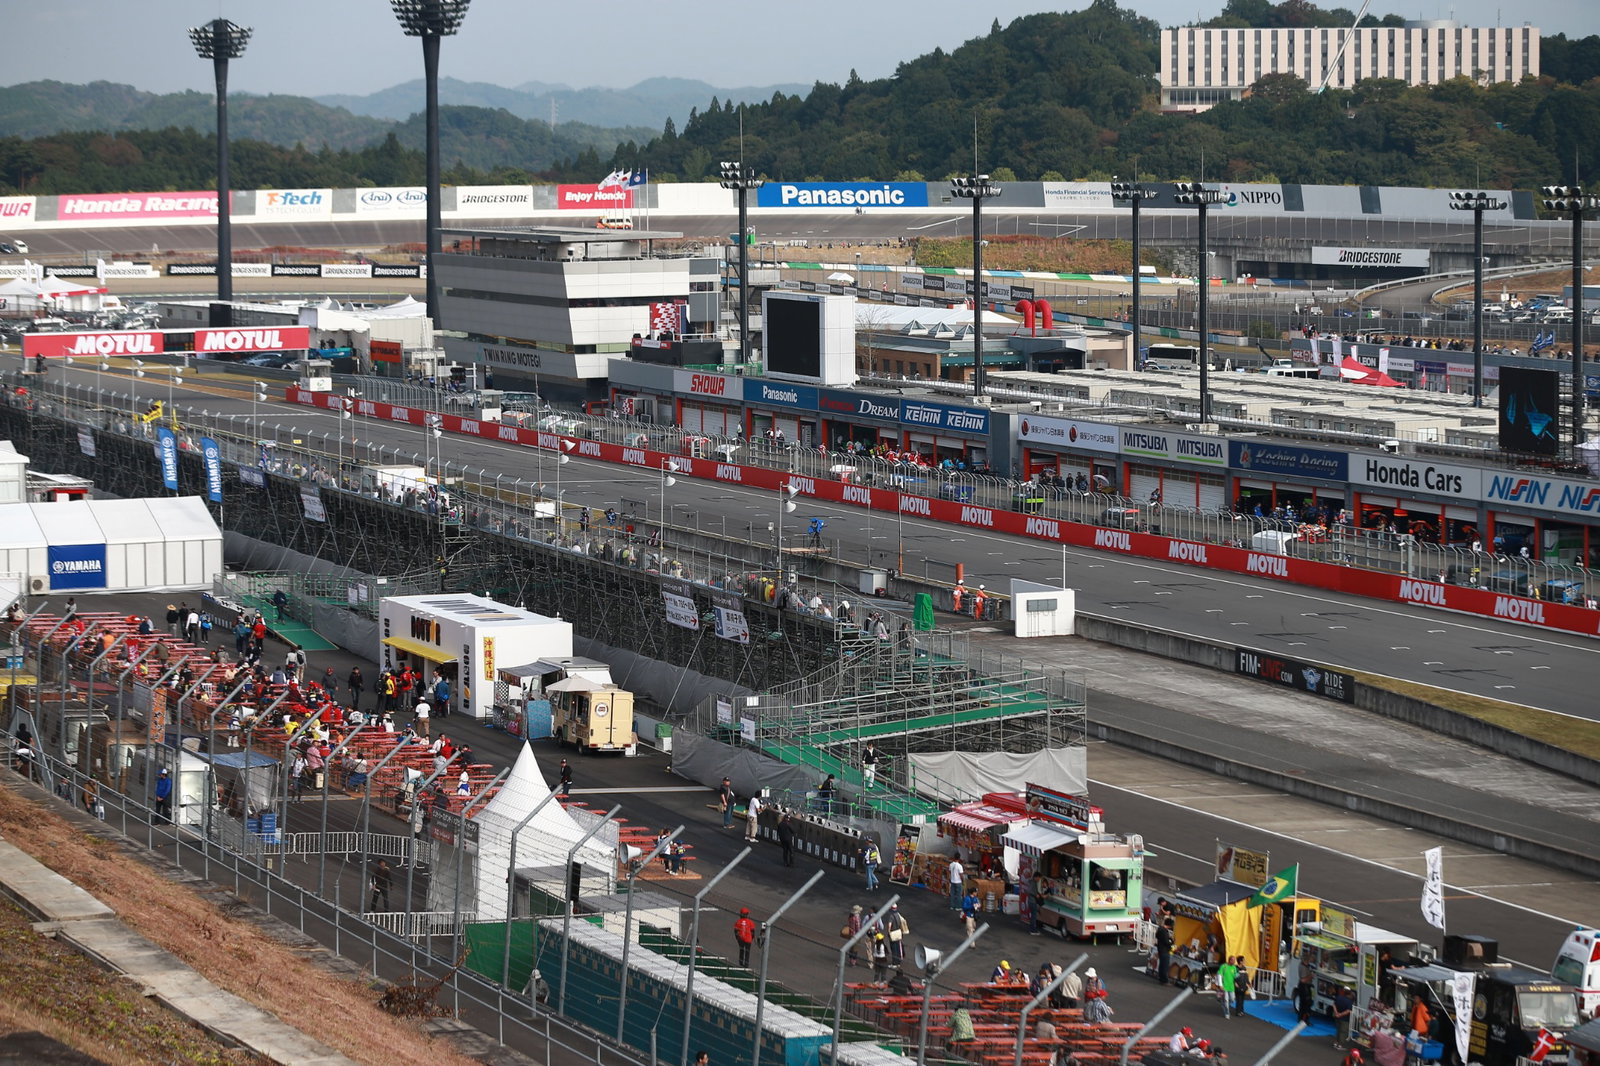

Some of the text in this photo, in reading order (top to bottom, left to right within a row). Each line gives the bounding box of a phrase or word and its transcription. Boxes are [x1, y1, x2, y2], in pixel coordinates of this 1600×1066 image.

[462, 194, 529, 203] BRIDGESTONE
[565, 191, 592, 203] Enjoy
[781, 184, 905, 205] Panasonic
[1240, 191, 1281, 205] NIPPO
[64, 198, 143, 214] Honda
[1338, 249, 1402, 264] BRIDGESTONE
[74, 333, 155, 354] MOTUL
[204, 330, 283, 350] MOTUL
[484, 348, 541, 368] TWIN RING MOTEGI
[690, 374, 725, 396] SHOWA
[763, 385, 798, 403] Panasonic
[858, 400, 899, 418] DREAM
[905, 406, 941, 424] KEIHIN
[947, 411, 984, 430] KEIHIN
[579, 441, 601, 457] MOTUL
[1124, 432, 1168, 451] MITSUBA
[1176, 438, 1223, 458] MITSUBA
[622, 448, 646, 464] MOTUL
[207, 458, 221, 493] YAMAHA
[716, 464, 742, 481] MOTUL
[1366, 459, 1462, 493] Honda Cars
[842, 486, 871, 503] MOTUL
[900, 496, 931, 515] MOTUL
[961, 506, 993, 526] MOTUL
[1026, 517, 1060, 538] MOTUL
[1095, 529, 1132, 551] MOTUL
[1168, 541, 1208, 563] MOTUL
[64, 559, 102, 571] YAMAHA
[1247, 553, 1288, 577] MOTUL
[1399, 579, 1446, 605] MOTUL
[1494, 596, 1545, 623] MOTUL
[1324, 671, 1343, 690] RIDE
